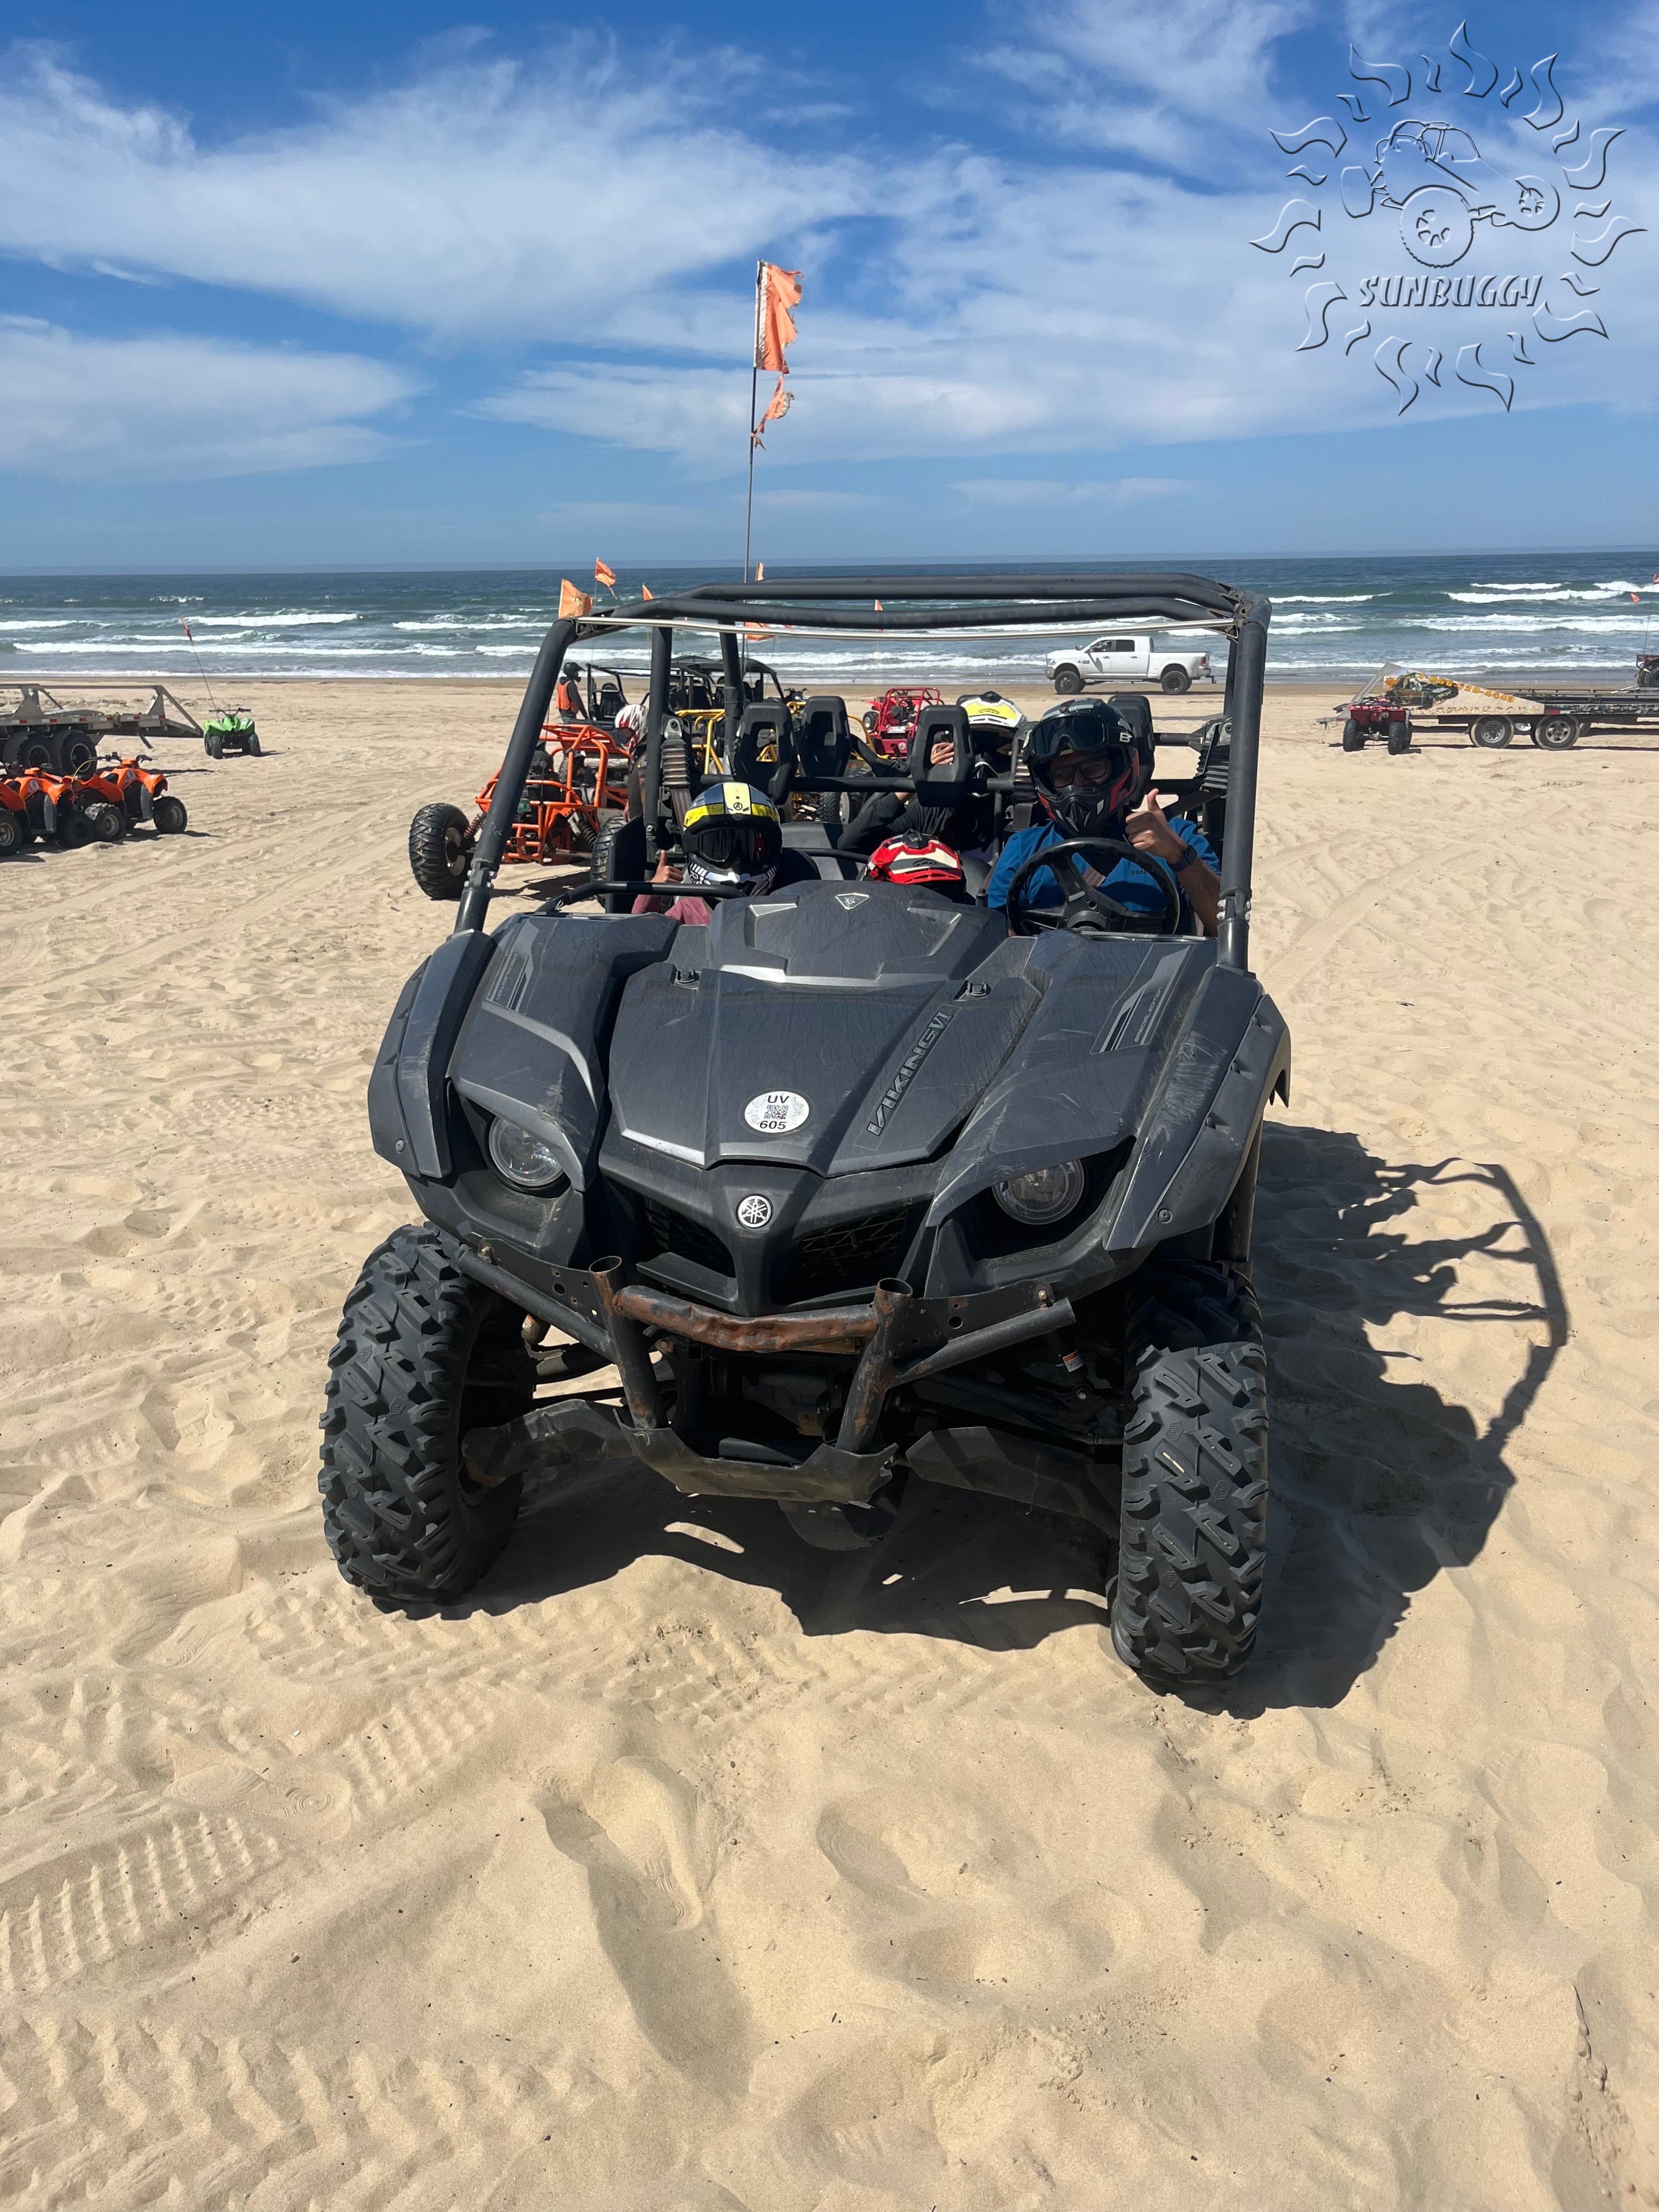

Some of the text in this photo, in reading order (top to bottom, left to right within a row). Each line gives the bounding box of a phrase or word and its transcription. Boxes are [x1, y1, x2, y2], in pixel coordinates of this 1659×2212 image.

[1134, 1013, 1151, 1042] SPECIAL
[866, 1028, 939, 1136] VIKING
[768, 1095, 789, 1104] UV
[759, 1120, 787, 1130] 605
